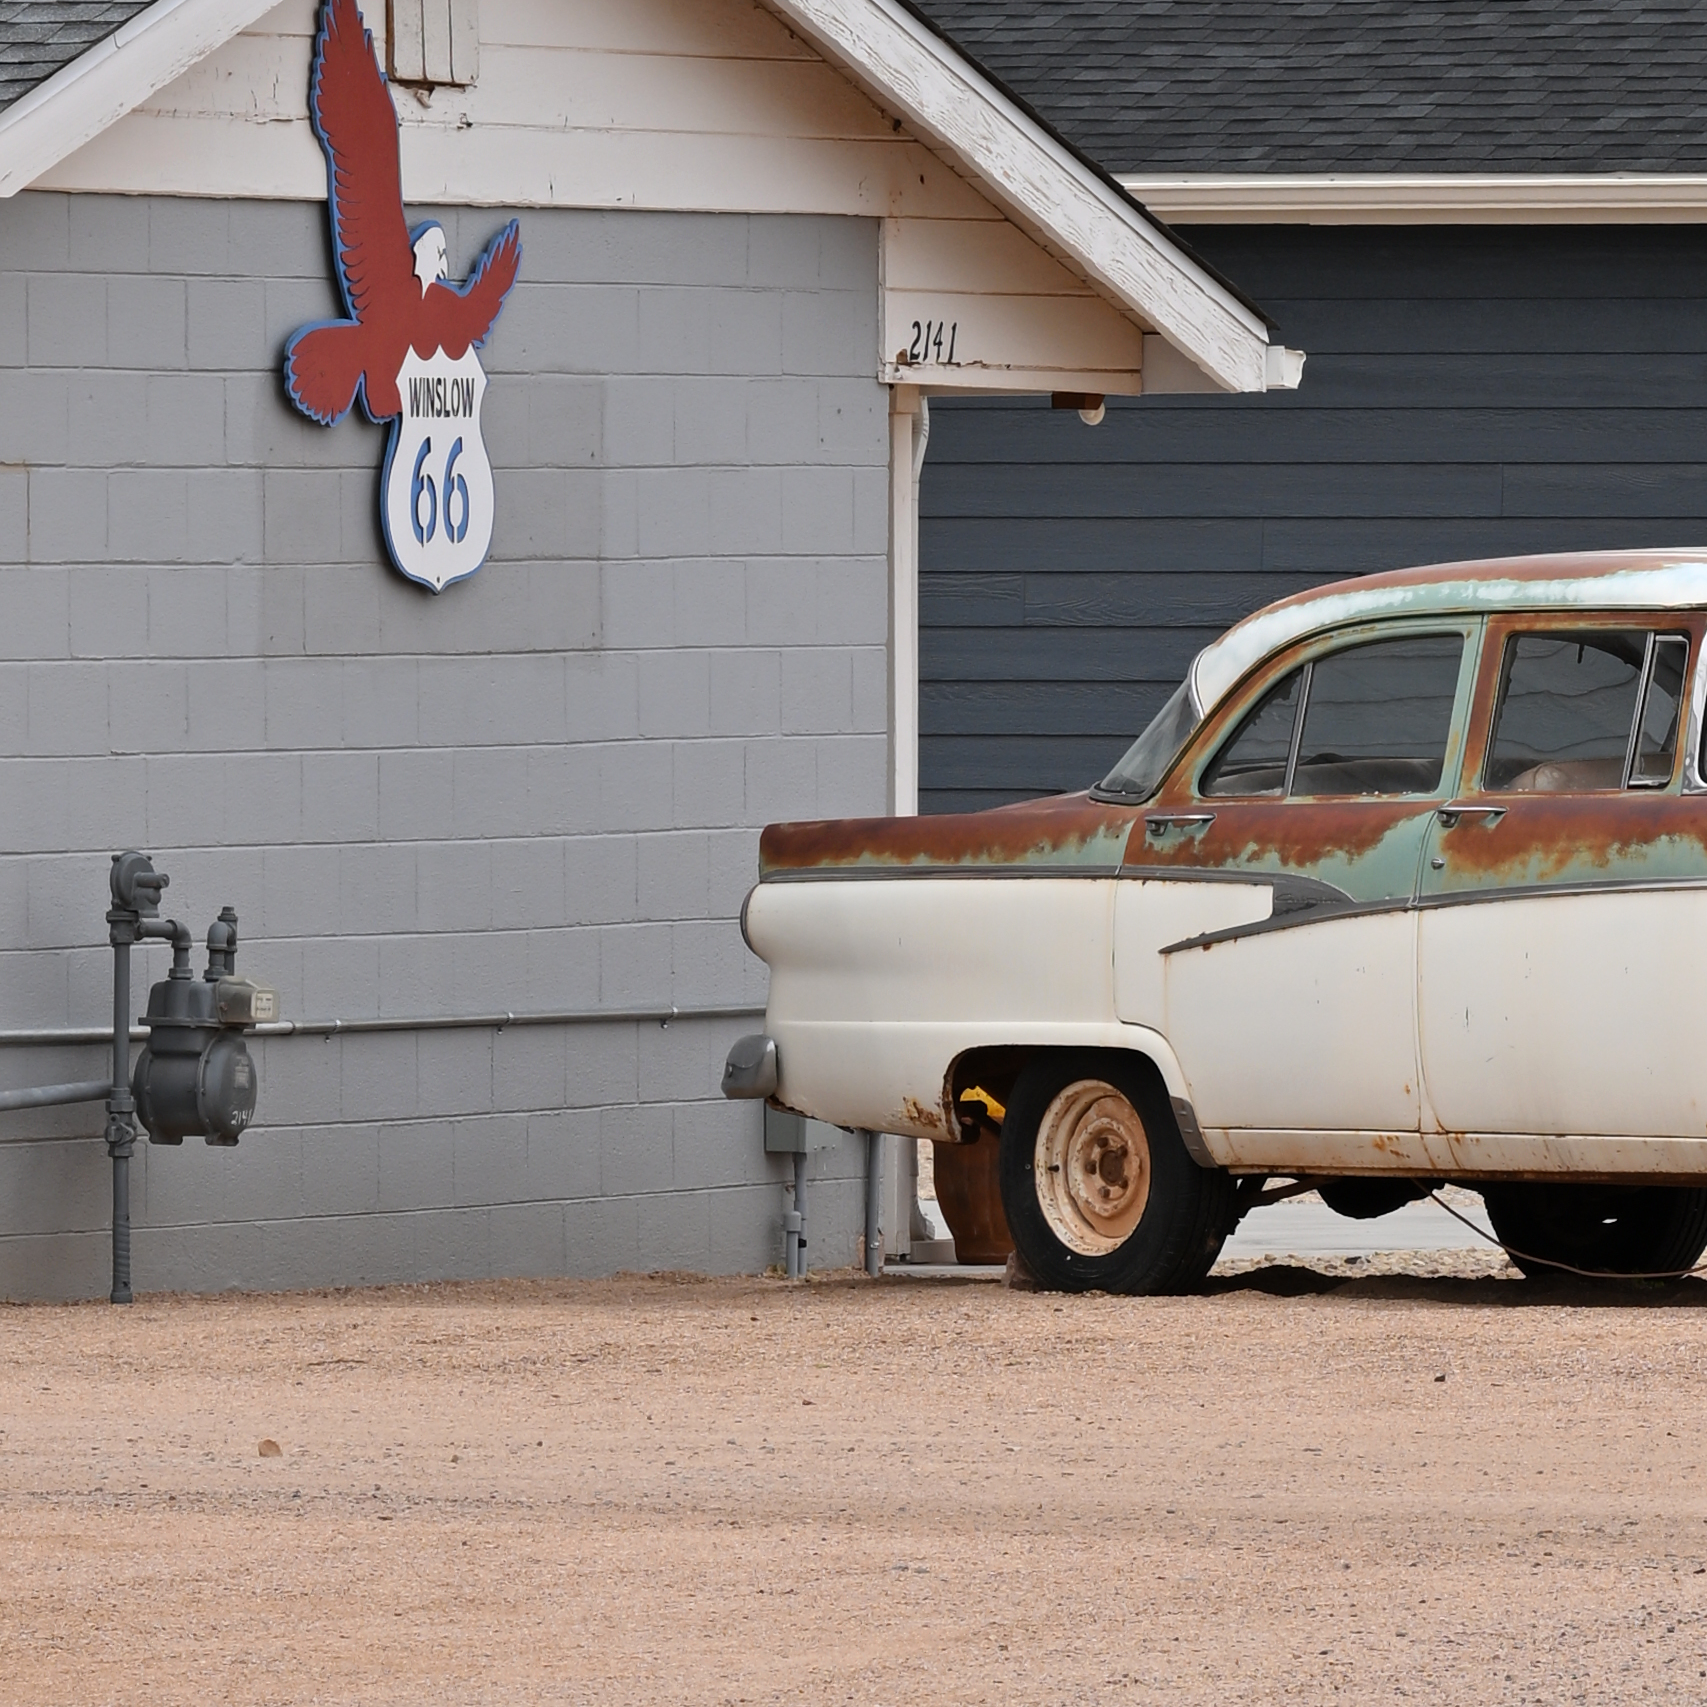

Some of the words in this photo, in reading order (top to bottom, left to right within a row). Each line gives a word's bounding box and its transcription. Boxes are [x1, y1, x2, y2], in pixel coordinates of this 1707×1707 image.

[910, 320, 959, 364] 2141
[408, 377, 474, 417] WINSLOW
[410, 436, 470, 545] 66
